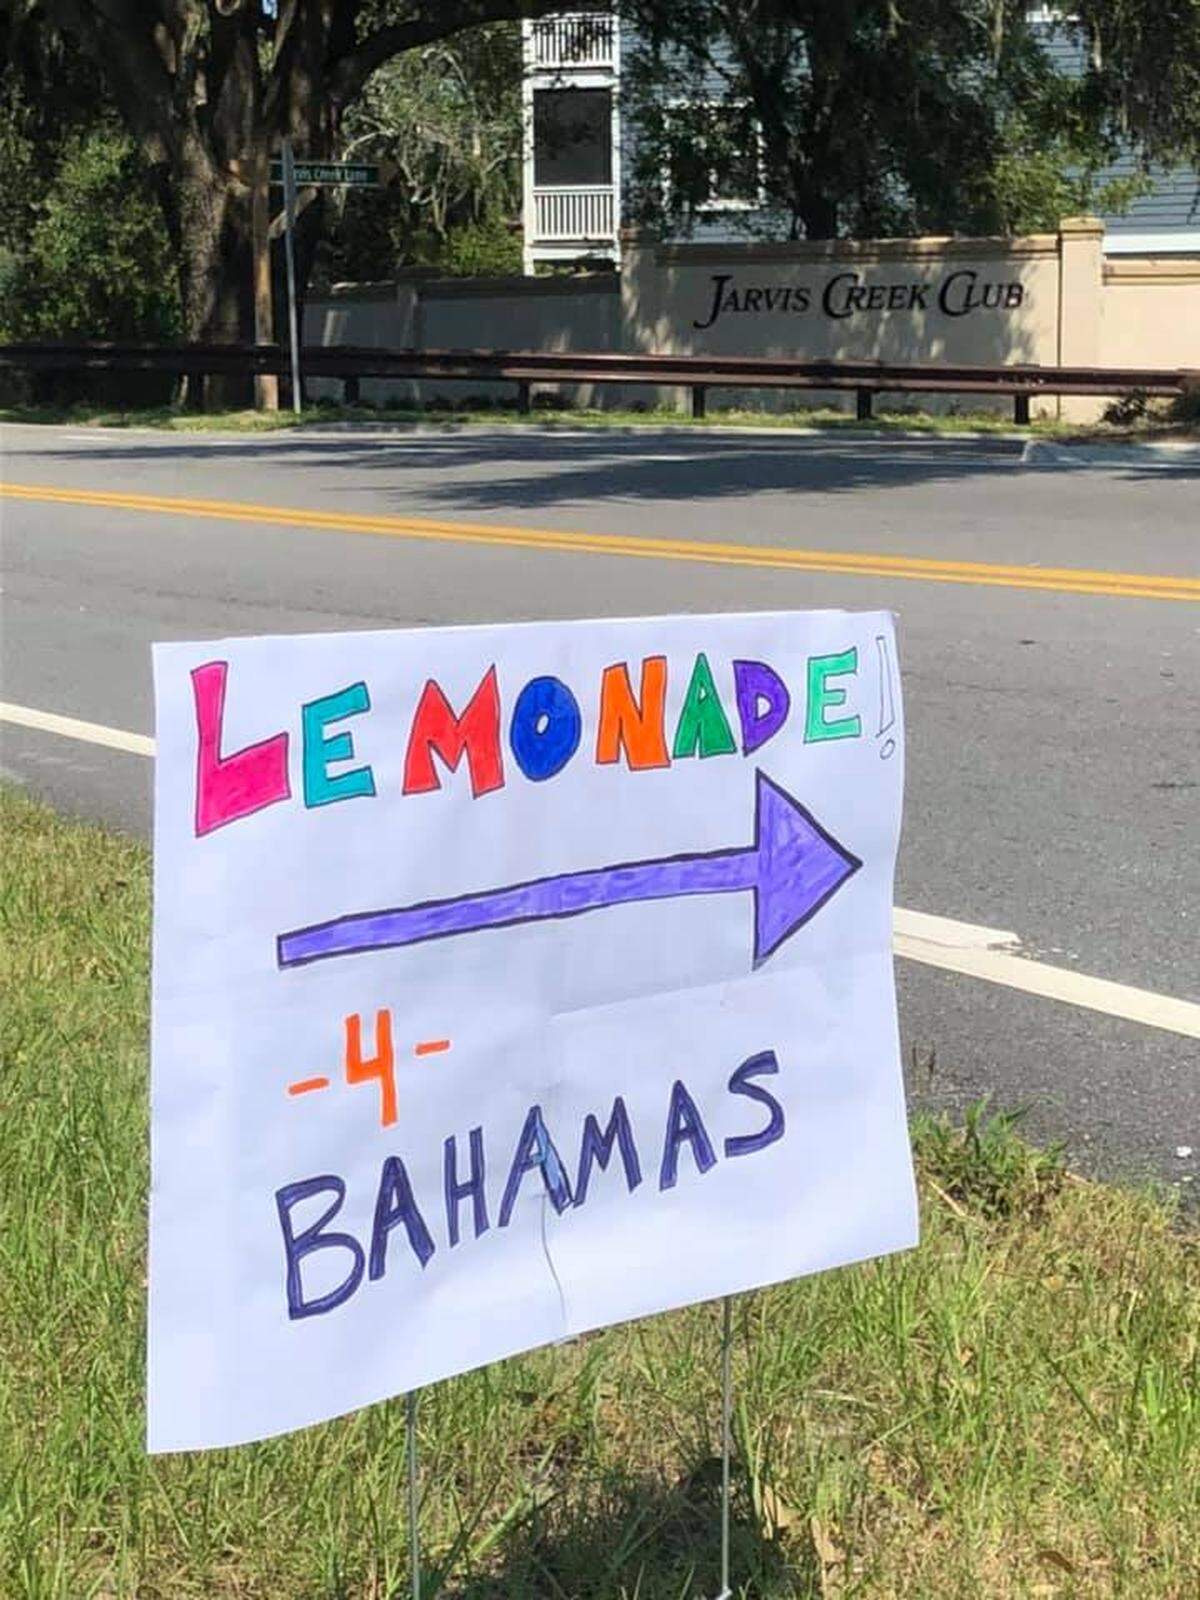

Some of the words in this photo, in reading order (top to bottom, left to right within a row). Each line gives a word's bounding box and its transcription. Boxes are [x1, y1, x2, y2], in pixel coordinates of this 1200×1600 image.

[693, 274, 811, 329] JARVIS
[822, 272, 931, 319] CREEK
[938, 270, 1024, 317] CLUB
[190, 636, 896, 837] LEMONADE!
[275, 1050, 786, 1321] BAHAMAS
